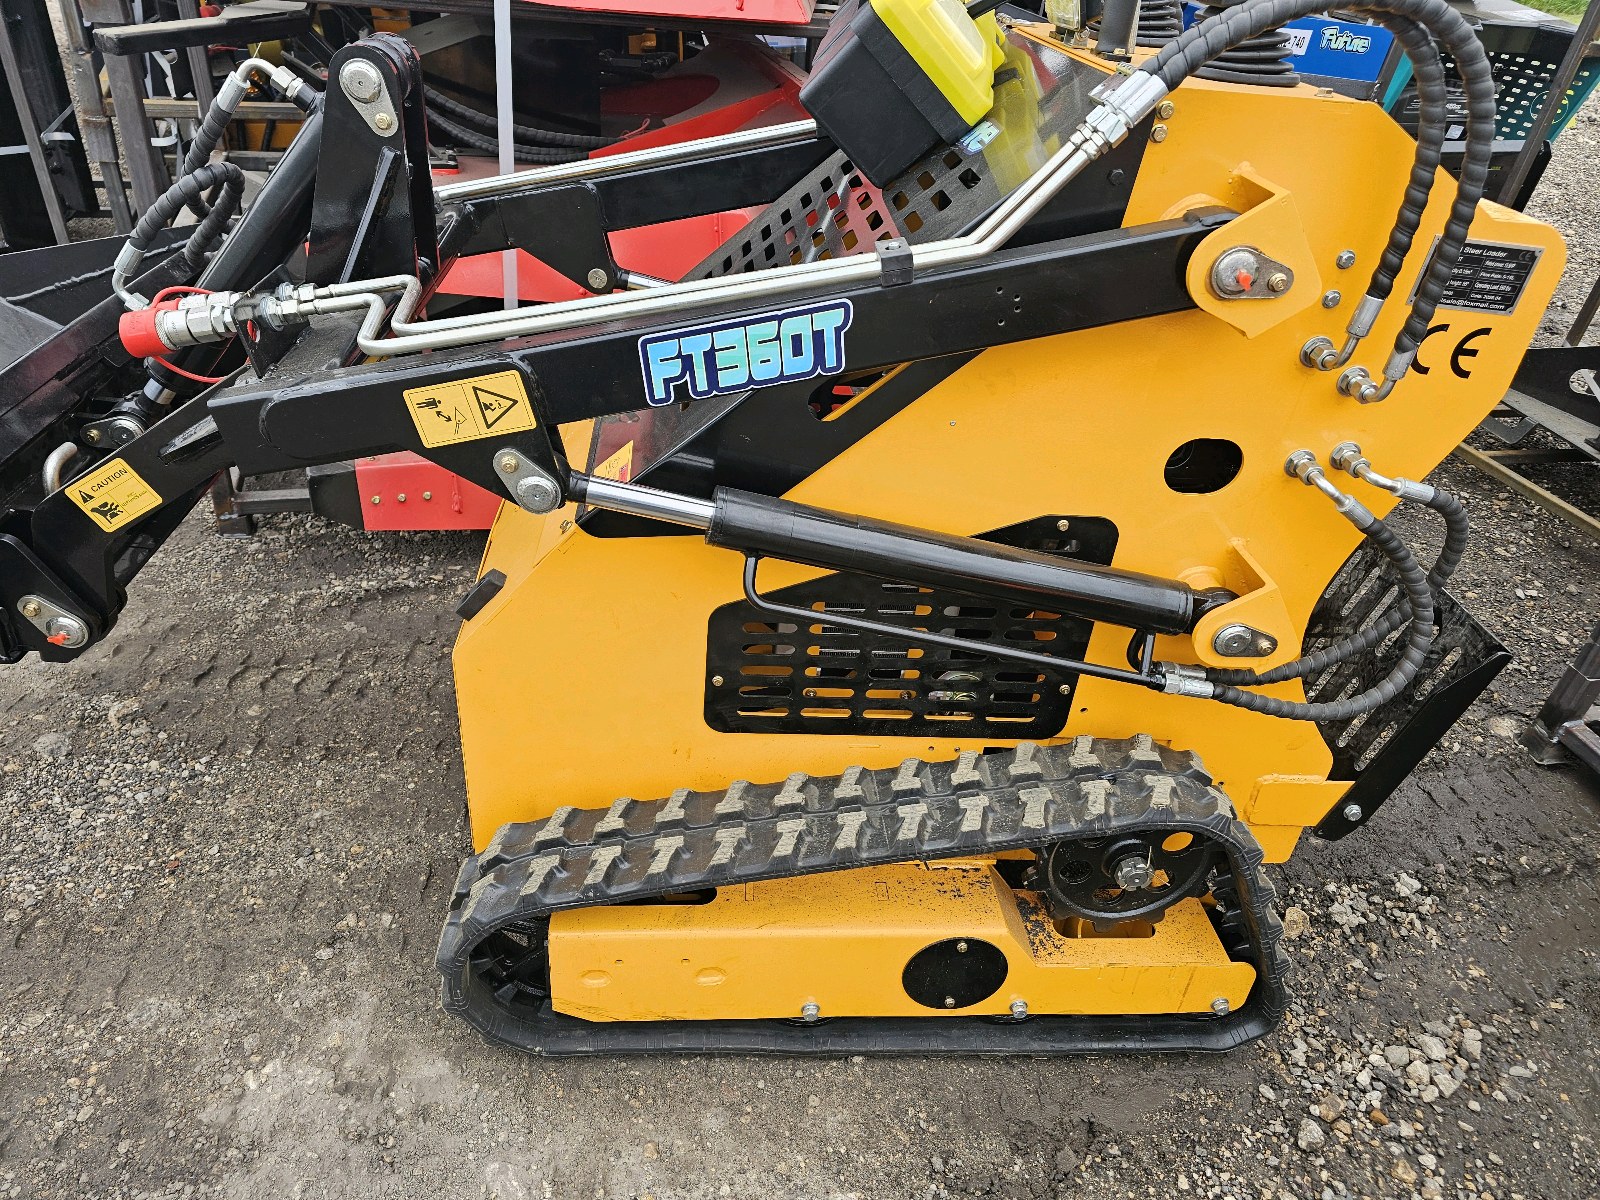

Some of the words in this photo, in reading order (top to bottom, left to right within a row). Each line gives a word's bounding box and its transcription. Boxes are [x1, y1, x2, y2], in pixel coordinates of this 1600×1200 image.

[1320, 26, 1371, 54] Future
[1463, 246, 1483, 254] Steer
[1483, 249, 1508, 257] Loader
[641, 302, 850, 404] FT360T
[1410, 323, 1493, 379] CE
[90, 468, 128, 493] CAUTION
